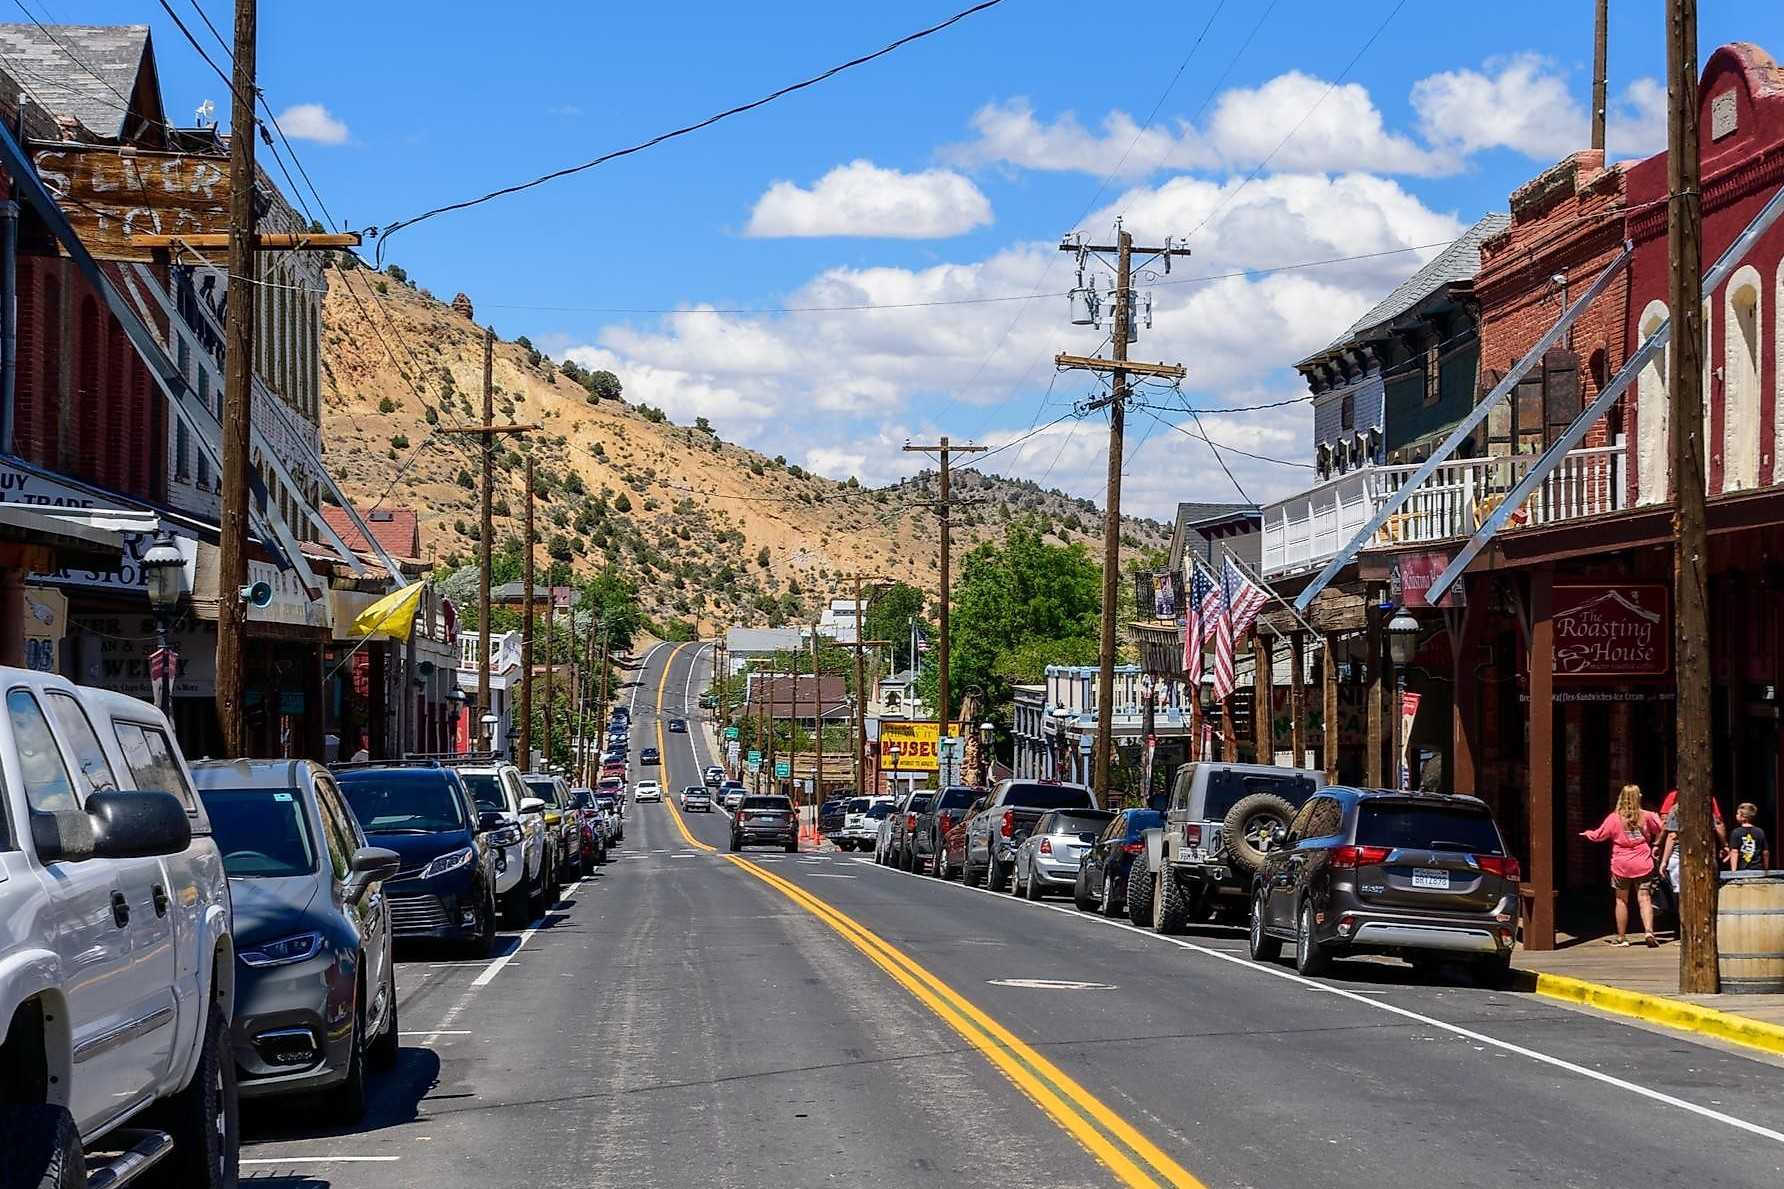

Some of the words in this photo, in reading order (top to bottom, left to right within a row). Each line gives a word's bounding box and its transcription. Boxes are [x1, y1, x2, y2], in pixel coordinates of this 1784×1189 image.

[34, 149, 223, 200] SLVER
[1580, 611, 1603, 623] The
[1557, 617, 1652, 647] Roasting
[1590, 638, 1655, 661] House
[883, 741, 938, 757] MUSEU
